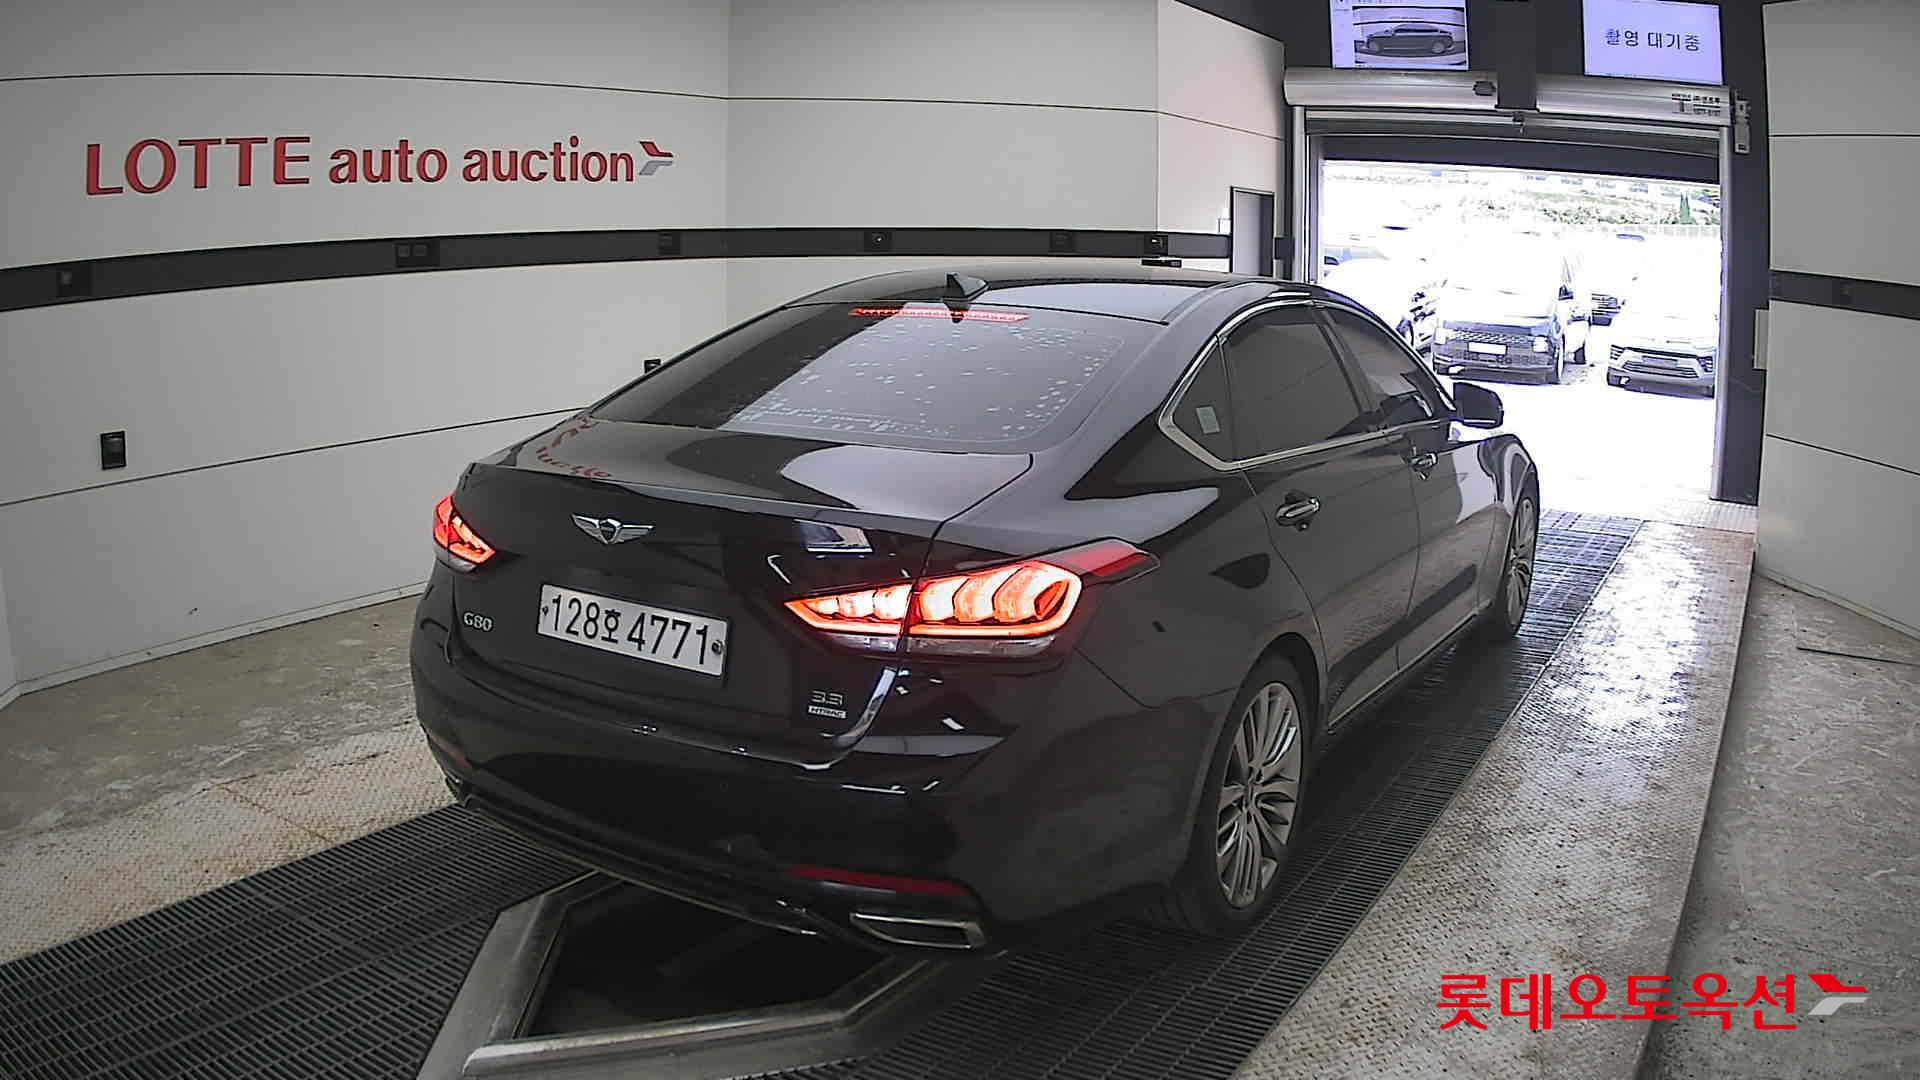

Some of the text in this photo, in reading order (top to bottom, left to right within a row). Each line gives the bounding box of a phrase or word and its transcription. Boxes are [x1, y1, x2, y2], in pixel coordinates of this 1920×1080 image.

[1605, 28, 1639, 47] 촬영
[86, 136, 635, 195] LOTTE auto auction
[463, 611, 493, 632] G80
